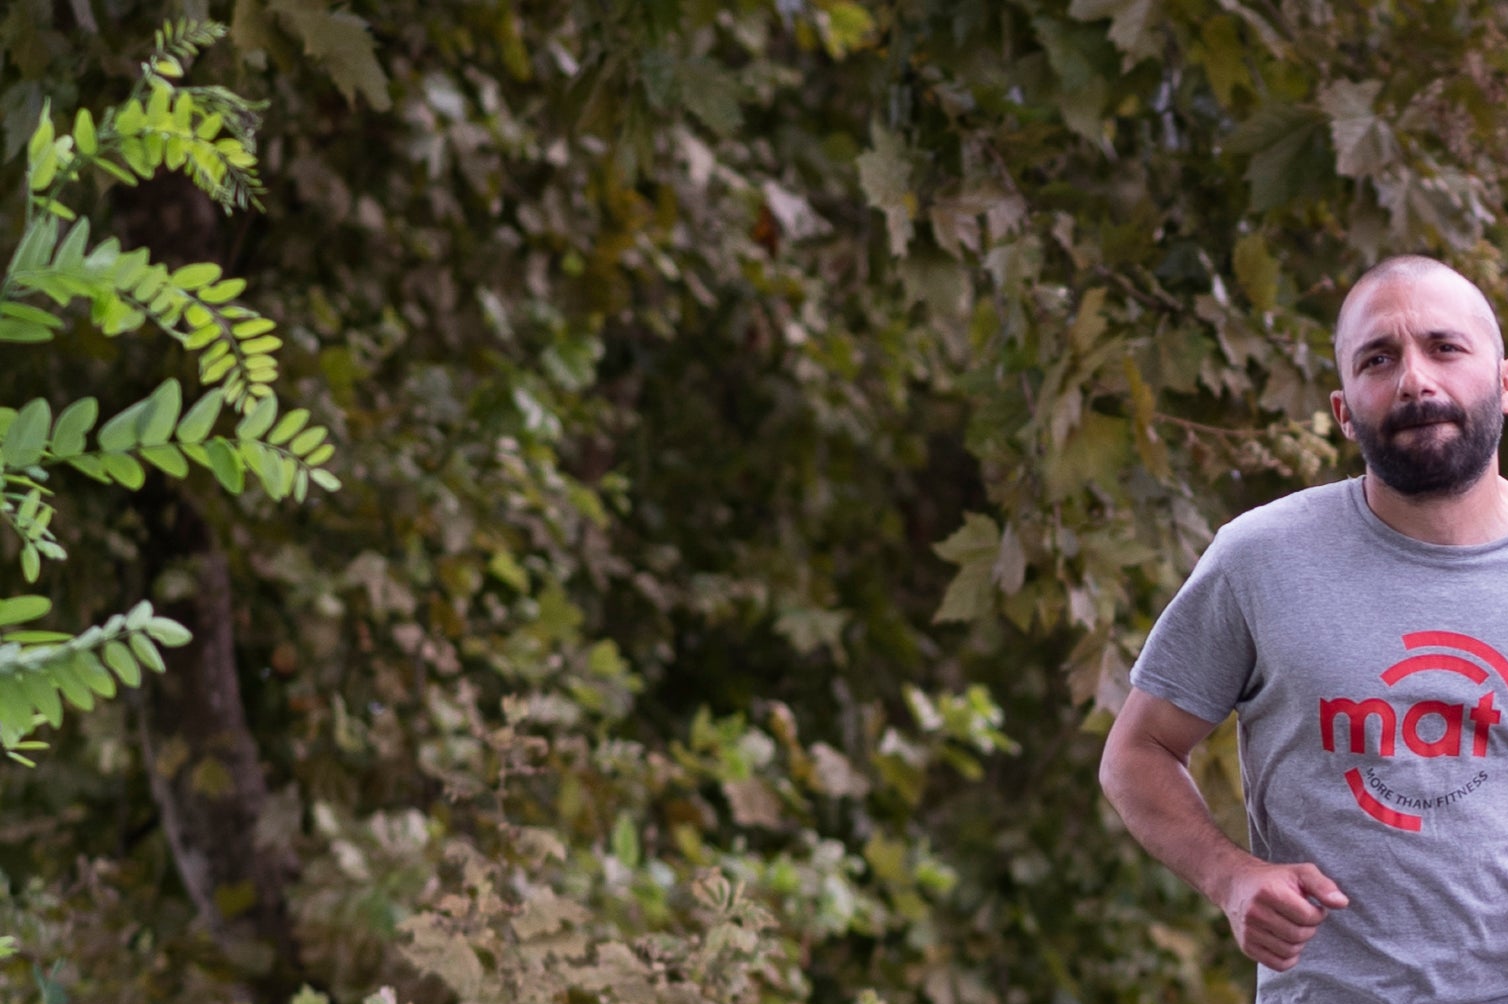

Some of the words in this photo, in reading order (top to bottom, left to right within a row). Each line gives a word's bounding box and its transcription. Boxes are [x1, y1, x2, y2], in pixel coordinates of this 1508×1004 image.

[1319, 691, 1502, 758] mat
[1365, 767, 1394, 800] MORE
[1396, 794, 1432, 809] THAN
[1437, 770, 1488, 807] FITNESS
